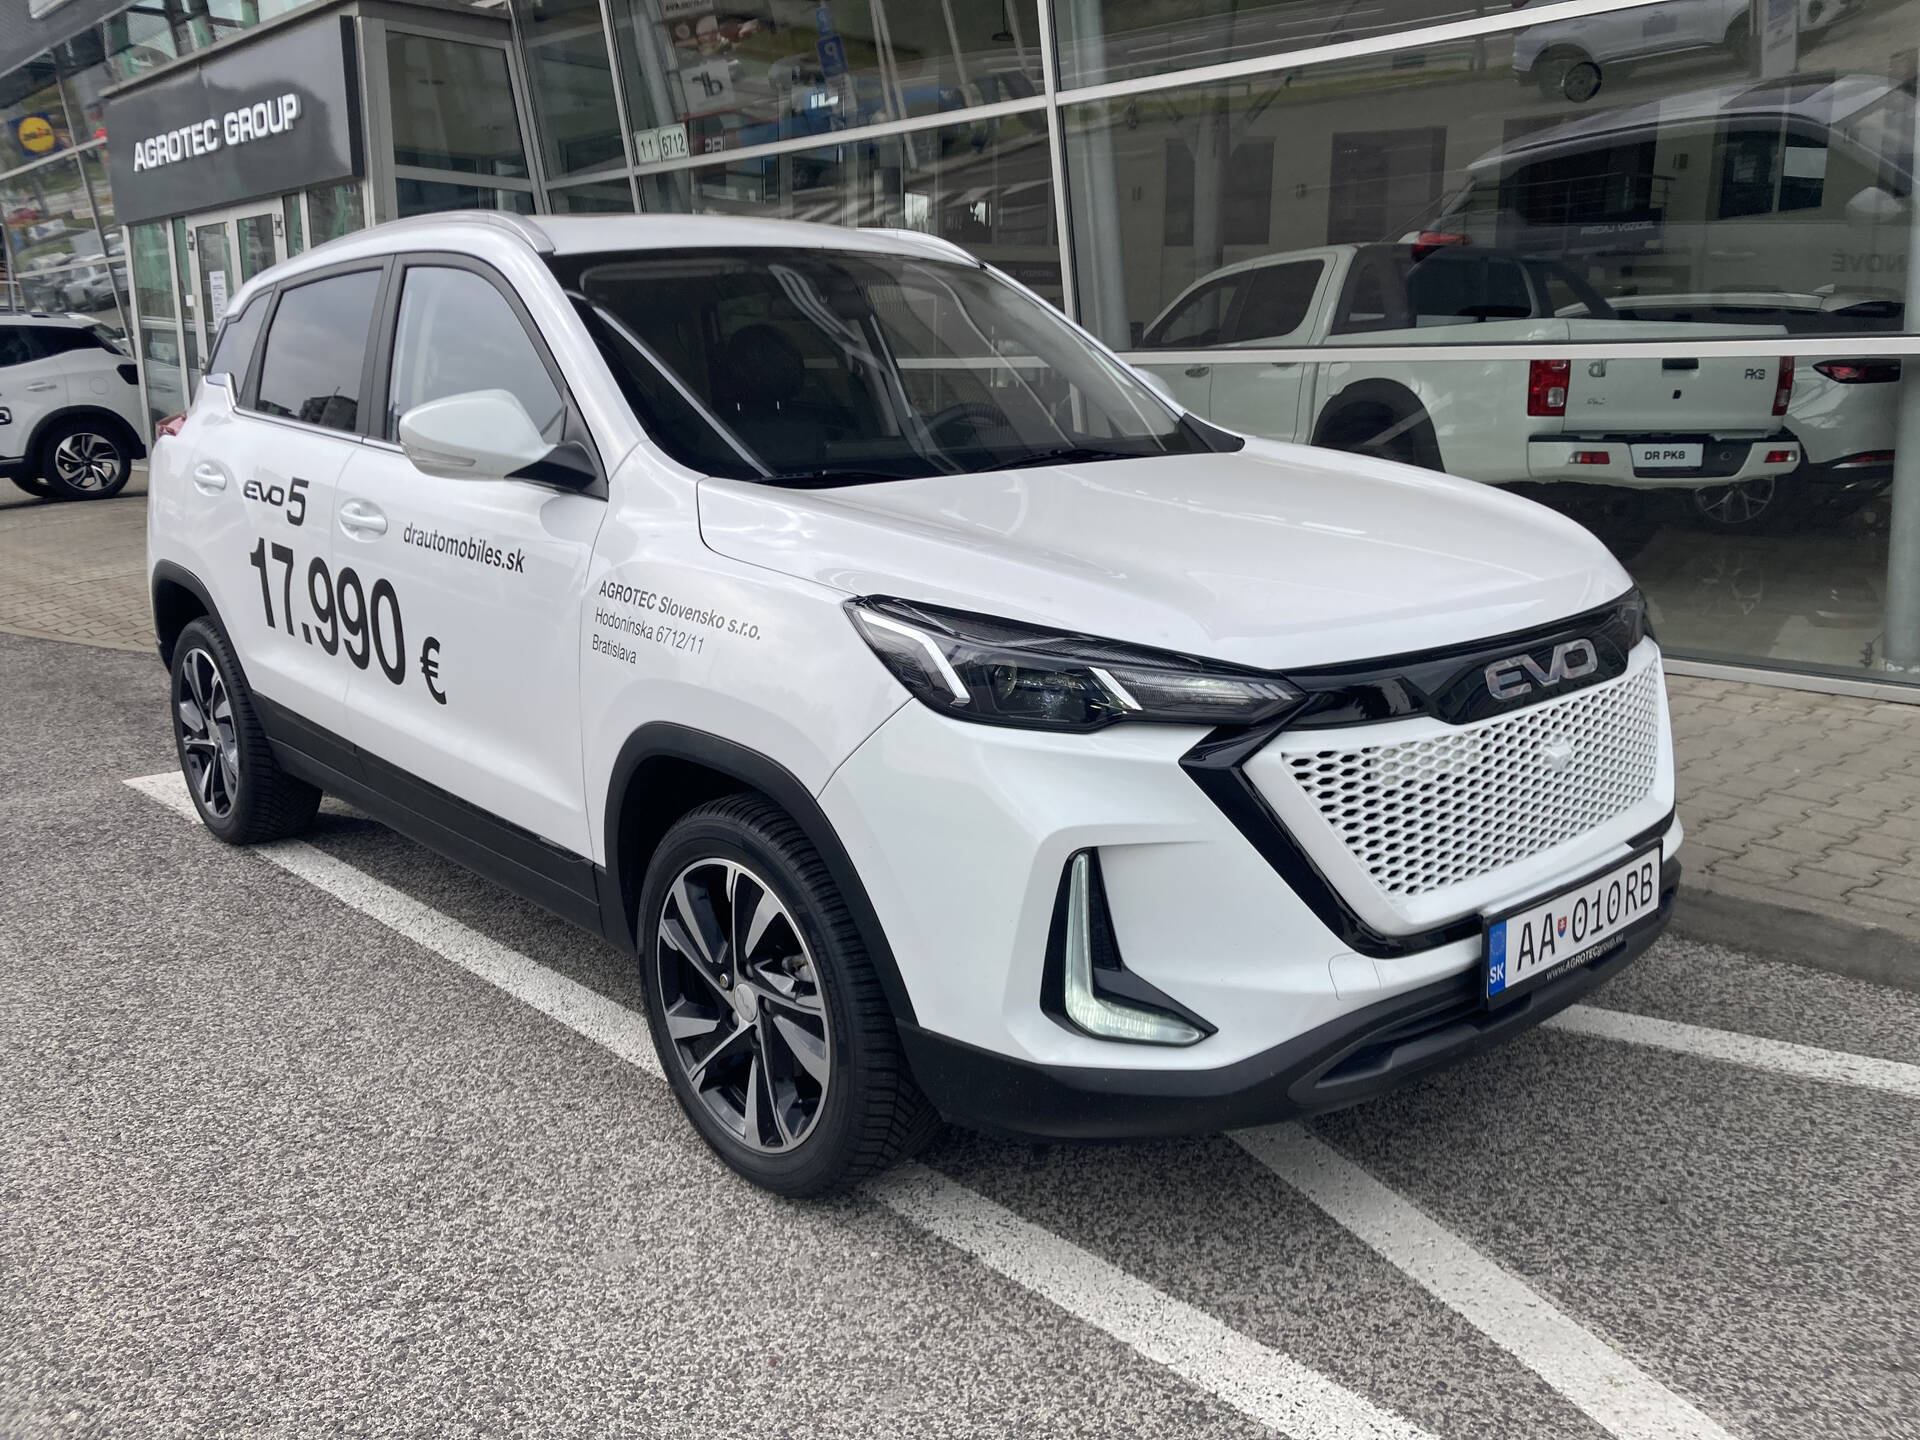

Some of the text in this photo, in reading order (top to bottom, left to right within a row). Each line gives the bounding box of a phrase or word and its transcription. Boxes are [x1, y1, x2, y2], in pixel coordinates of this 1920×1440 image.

[134, 93, 301, 172] AGROTEC GROUP
[641, 138, 654, 159] 11
[661, 132, 685, 157] 6712
[1644, 449, 1686, 461] DR PK8
[286, 477, 309, 527] 5
[403, 522, 526, 573] drautomobiles.sk
[249, 536, 447, 705] 17.990 €
[594, 607, 705, 655] Hodonínska 6712/11
[598, 580, 761, 641] AGROTEC Slovensko s.r.o.
[592, 633, 638, 665] Bratislava
[1484, 638, 1598, 700] EVO
[1516, 912, 1556, 972] AA
[1489, 963, 1505, 984] SK
